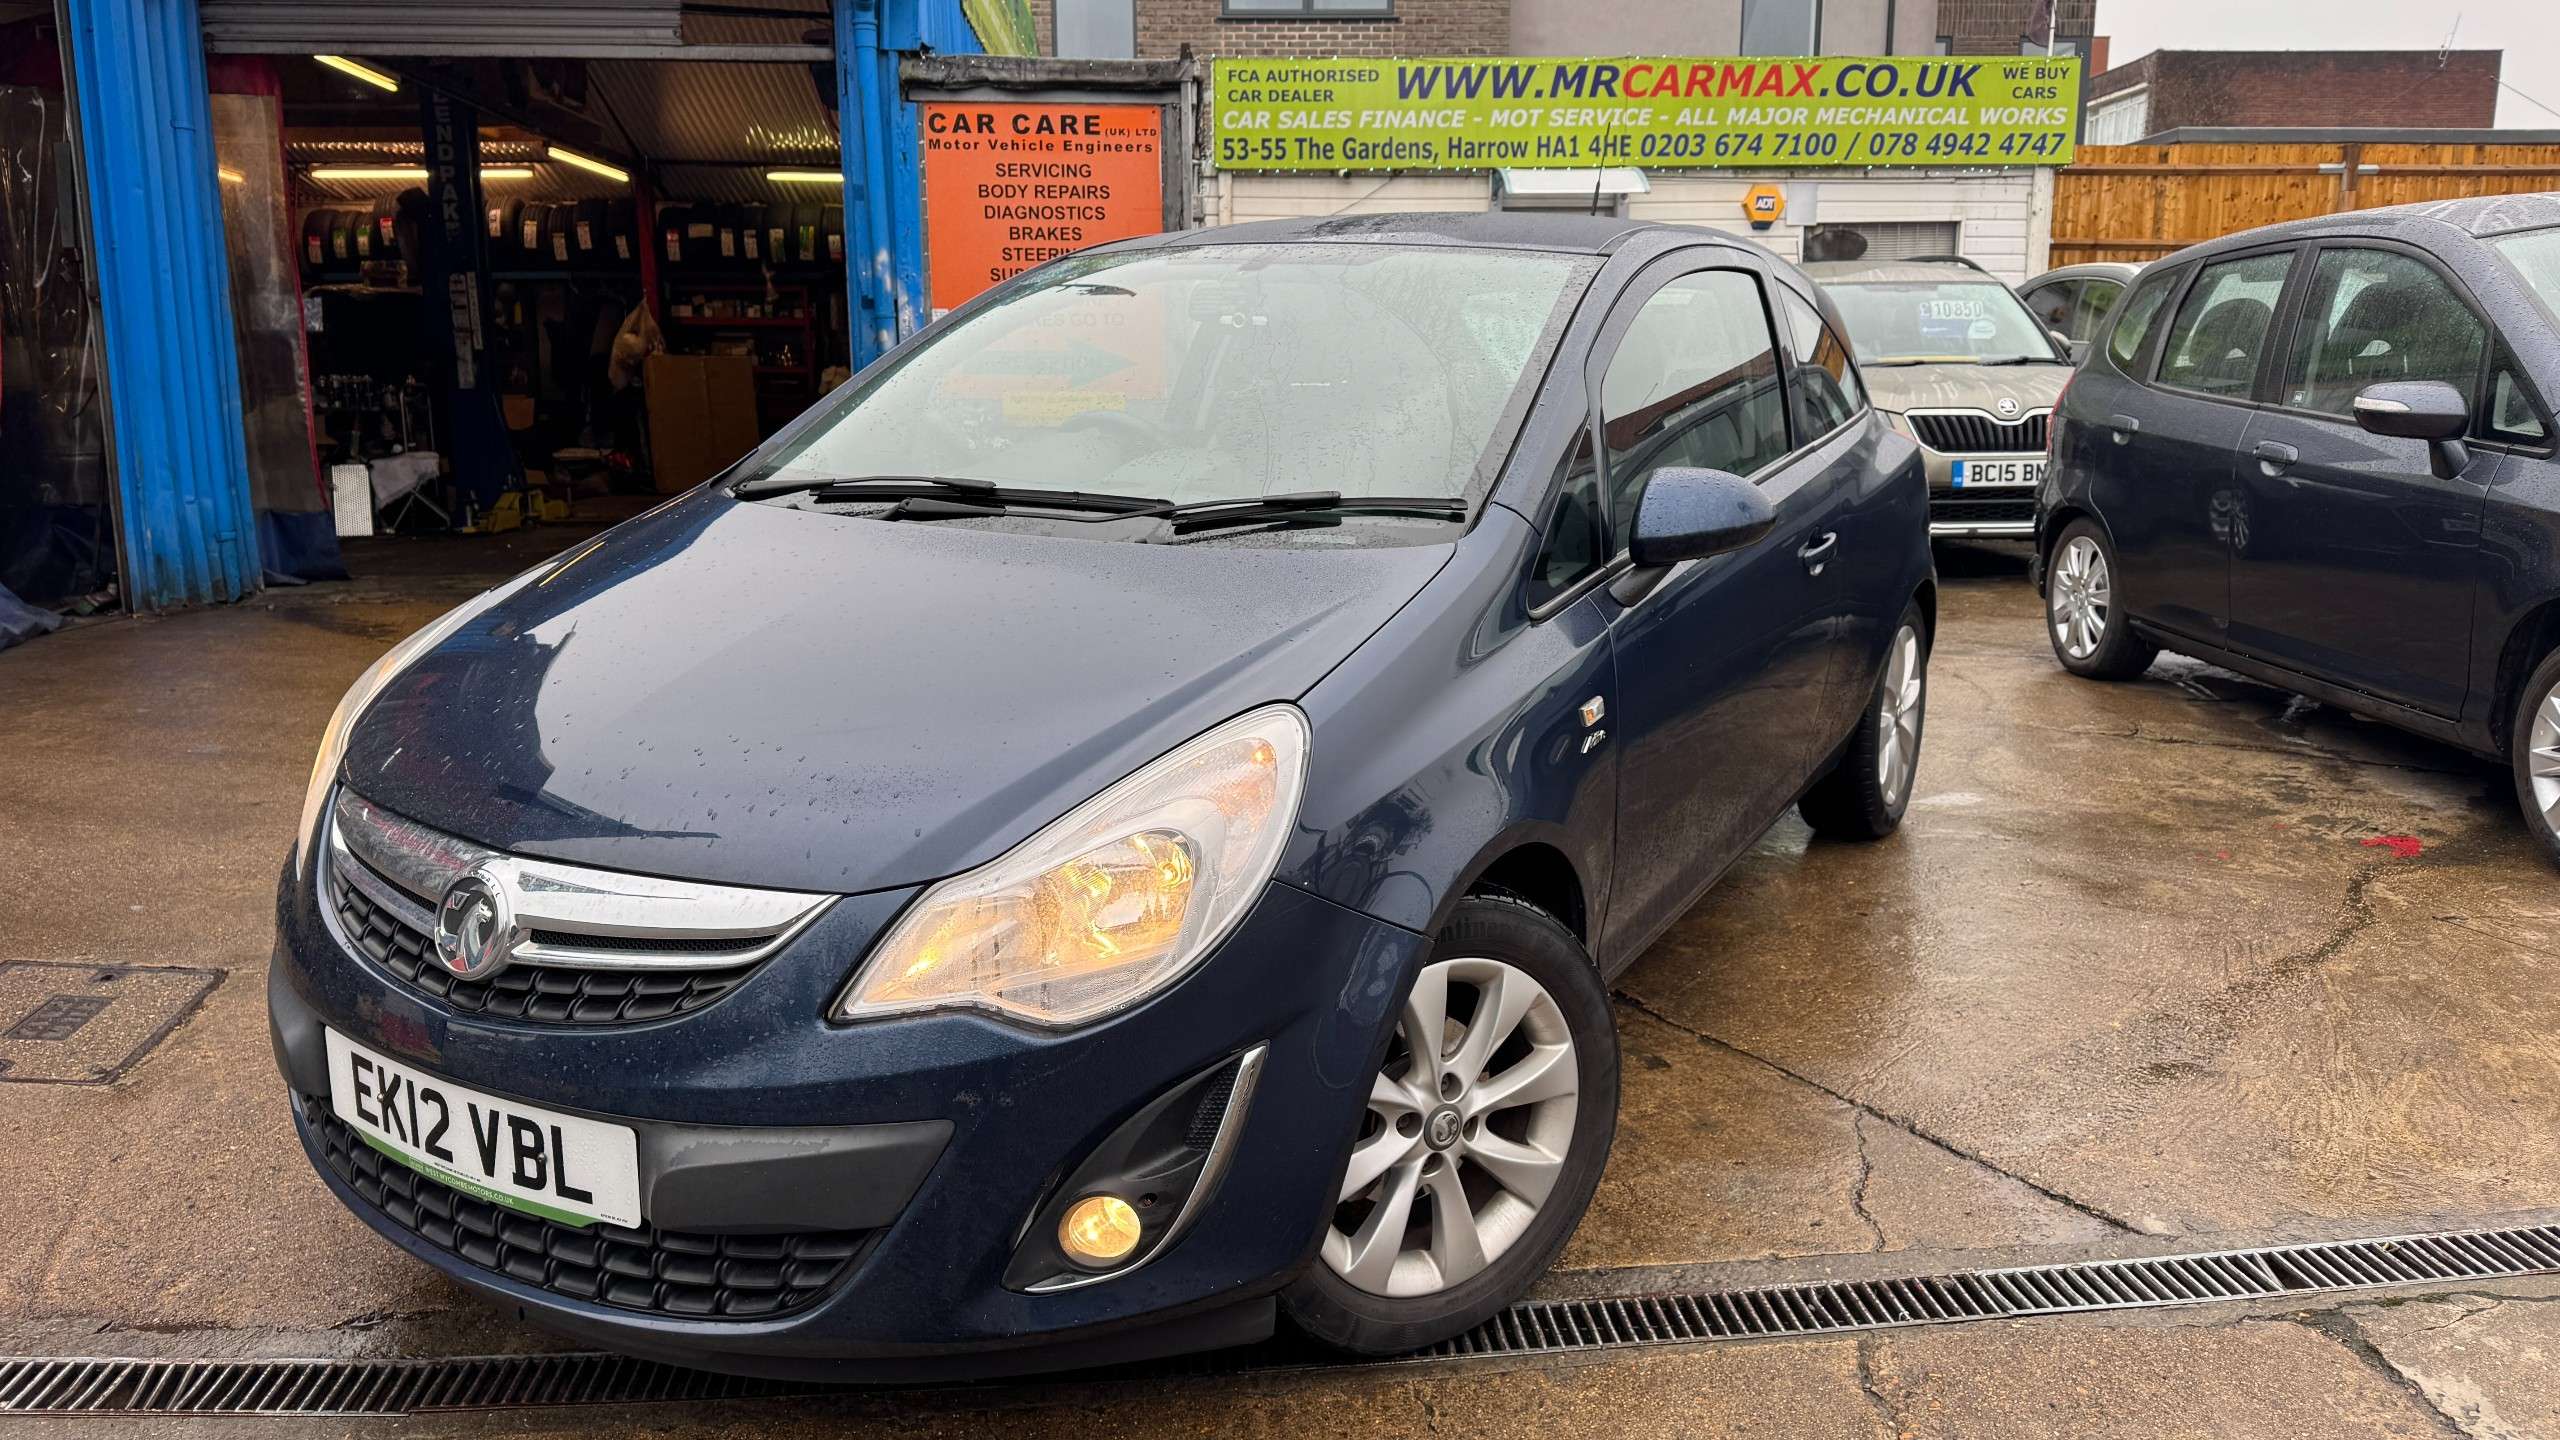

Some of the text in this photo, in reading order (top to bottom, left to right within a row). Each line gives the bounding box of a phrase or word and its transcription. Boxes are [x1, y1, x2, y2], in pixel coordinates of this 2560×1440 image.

[1228, 69, 1379, 83] FCA AUTHORISED
[1398, 63, 1982, 100] WWW.MRCARMAX.CO.UK
[2003, 67, 2070, 80] WE BUY
[1228, 89, 1334, 103] CAR DEALER
[2012, 86, 2057, 99] CARS
[928, 113, 1157, 138] CAR CARE (UK) LTD
[1222, 110, 1273, 130] CAR
[1277, 110, 1352, 130] SALES
[1358, 109, 1466, 129] FINANCE
[1489, 109, 1542, 128] MOT
[1548, 108, 1651, 127] SERVICE
[1675, 108, 1719, 126] ALL
[1727, 108, 1809, 126] MAJOR
[1815, 107, 1970, 126] MECHANICAL
[1979, 107, 2067, 125] WORKS
[928, 139, 1153, 155] Motor Vehicle Engineers
[1223, 137, 1288, 161] 53-55
[1295, 137, 1337, 160] The
[1342, 136, 1439, 164] Gardens,
[1448, 135, 1528, 159] Harrow
[1536, 135, 1579, 158] HA1
[1588, 134, 1632, 158] 4HE
[1641, 133, 1706, 158] 0203
[1714, 133, 1763, 157] 674
[1773, 132, 1837, 157] 7100
[1869, 132, 1918, 157] 078
[1925, 132, 1991, 156] 4942
[1999, 132, 2066, 156] 4747
[995, 163, 1092, 178] SERVICING
[978, 184, 1110, 200] BODY REPAIRS
[1755, 197, 1775, 209] ADT
[984, 205, 1106, 221] DIAGNOSTICS
[1009, 227, 1082, 241] BRAKES
[1971, 463, 2016, 482] BC15
[350, 1051, 594, 1205] EK12 VBL
